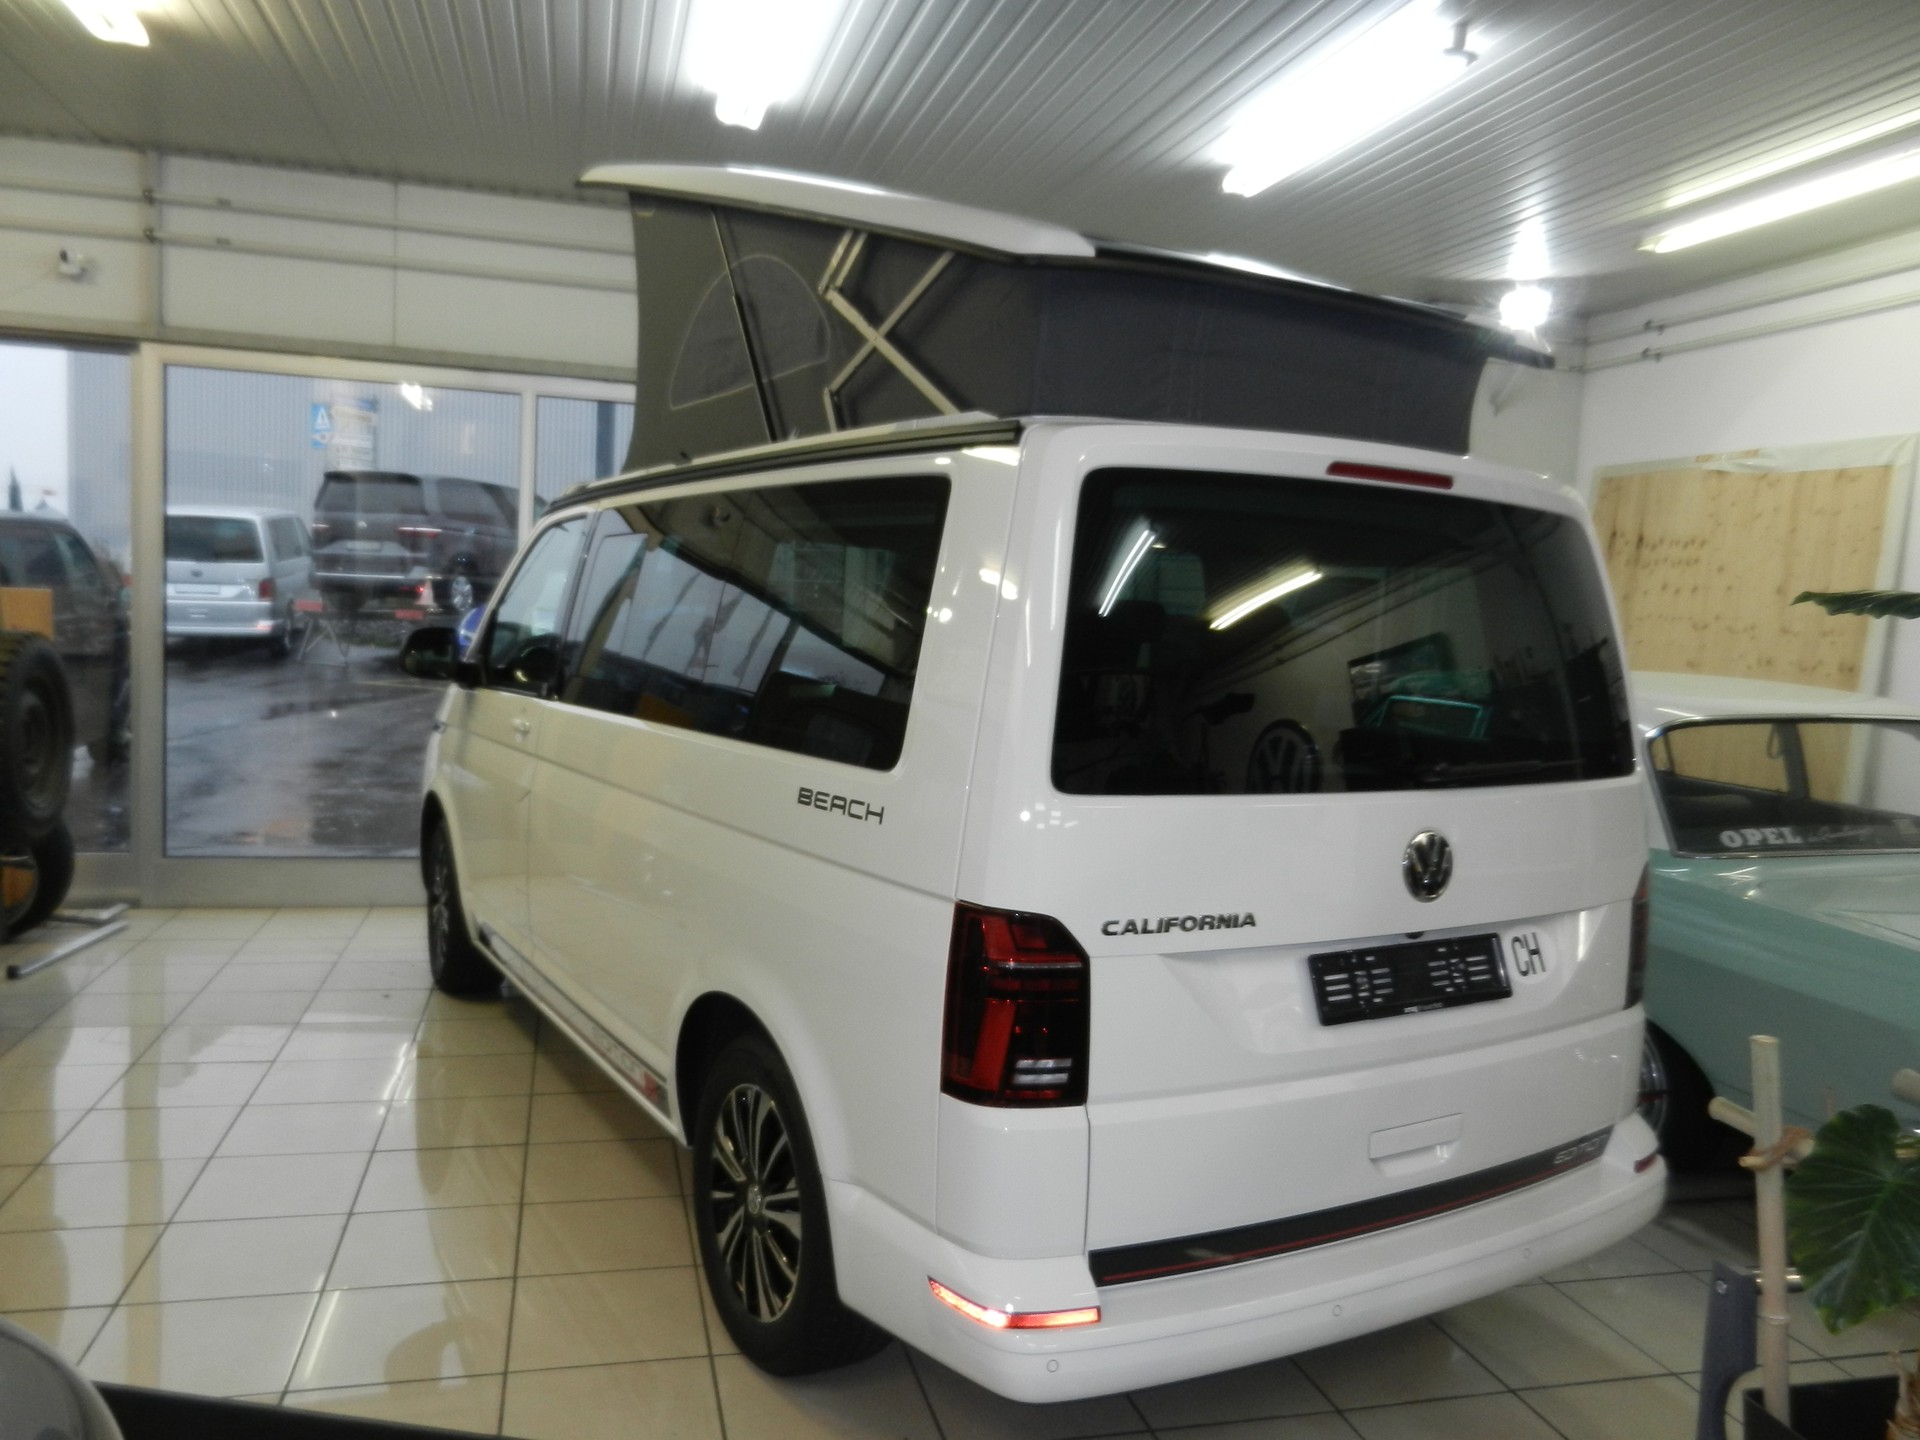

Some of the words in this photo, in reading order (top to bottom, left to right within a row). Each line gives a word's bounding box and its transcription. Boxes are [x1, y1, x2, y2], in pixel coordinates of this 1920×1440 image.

[798, 787, 884, 825] BEACH
[1719, 826, 1803, 848] OPEL
[1101, 912, 1256, 936] CALIFORNIA
[1511, 931, 1546, 977] CH
